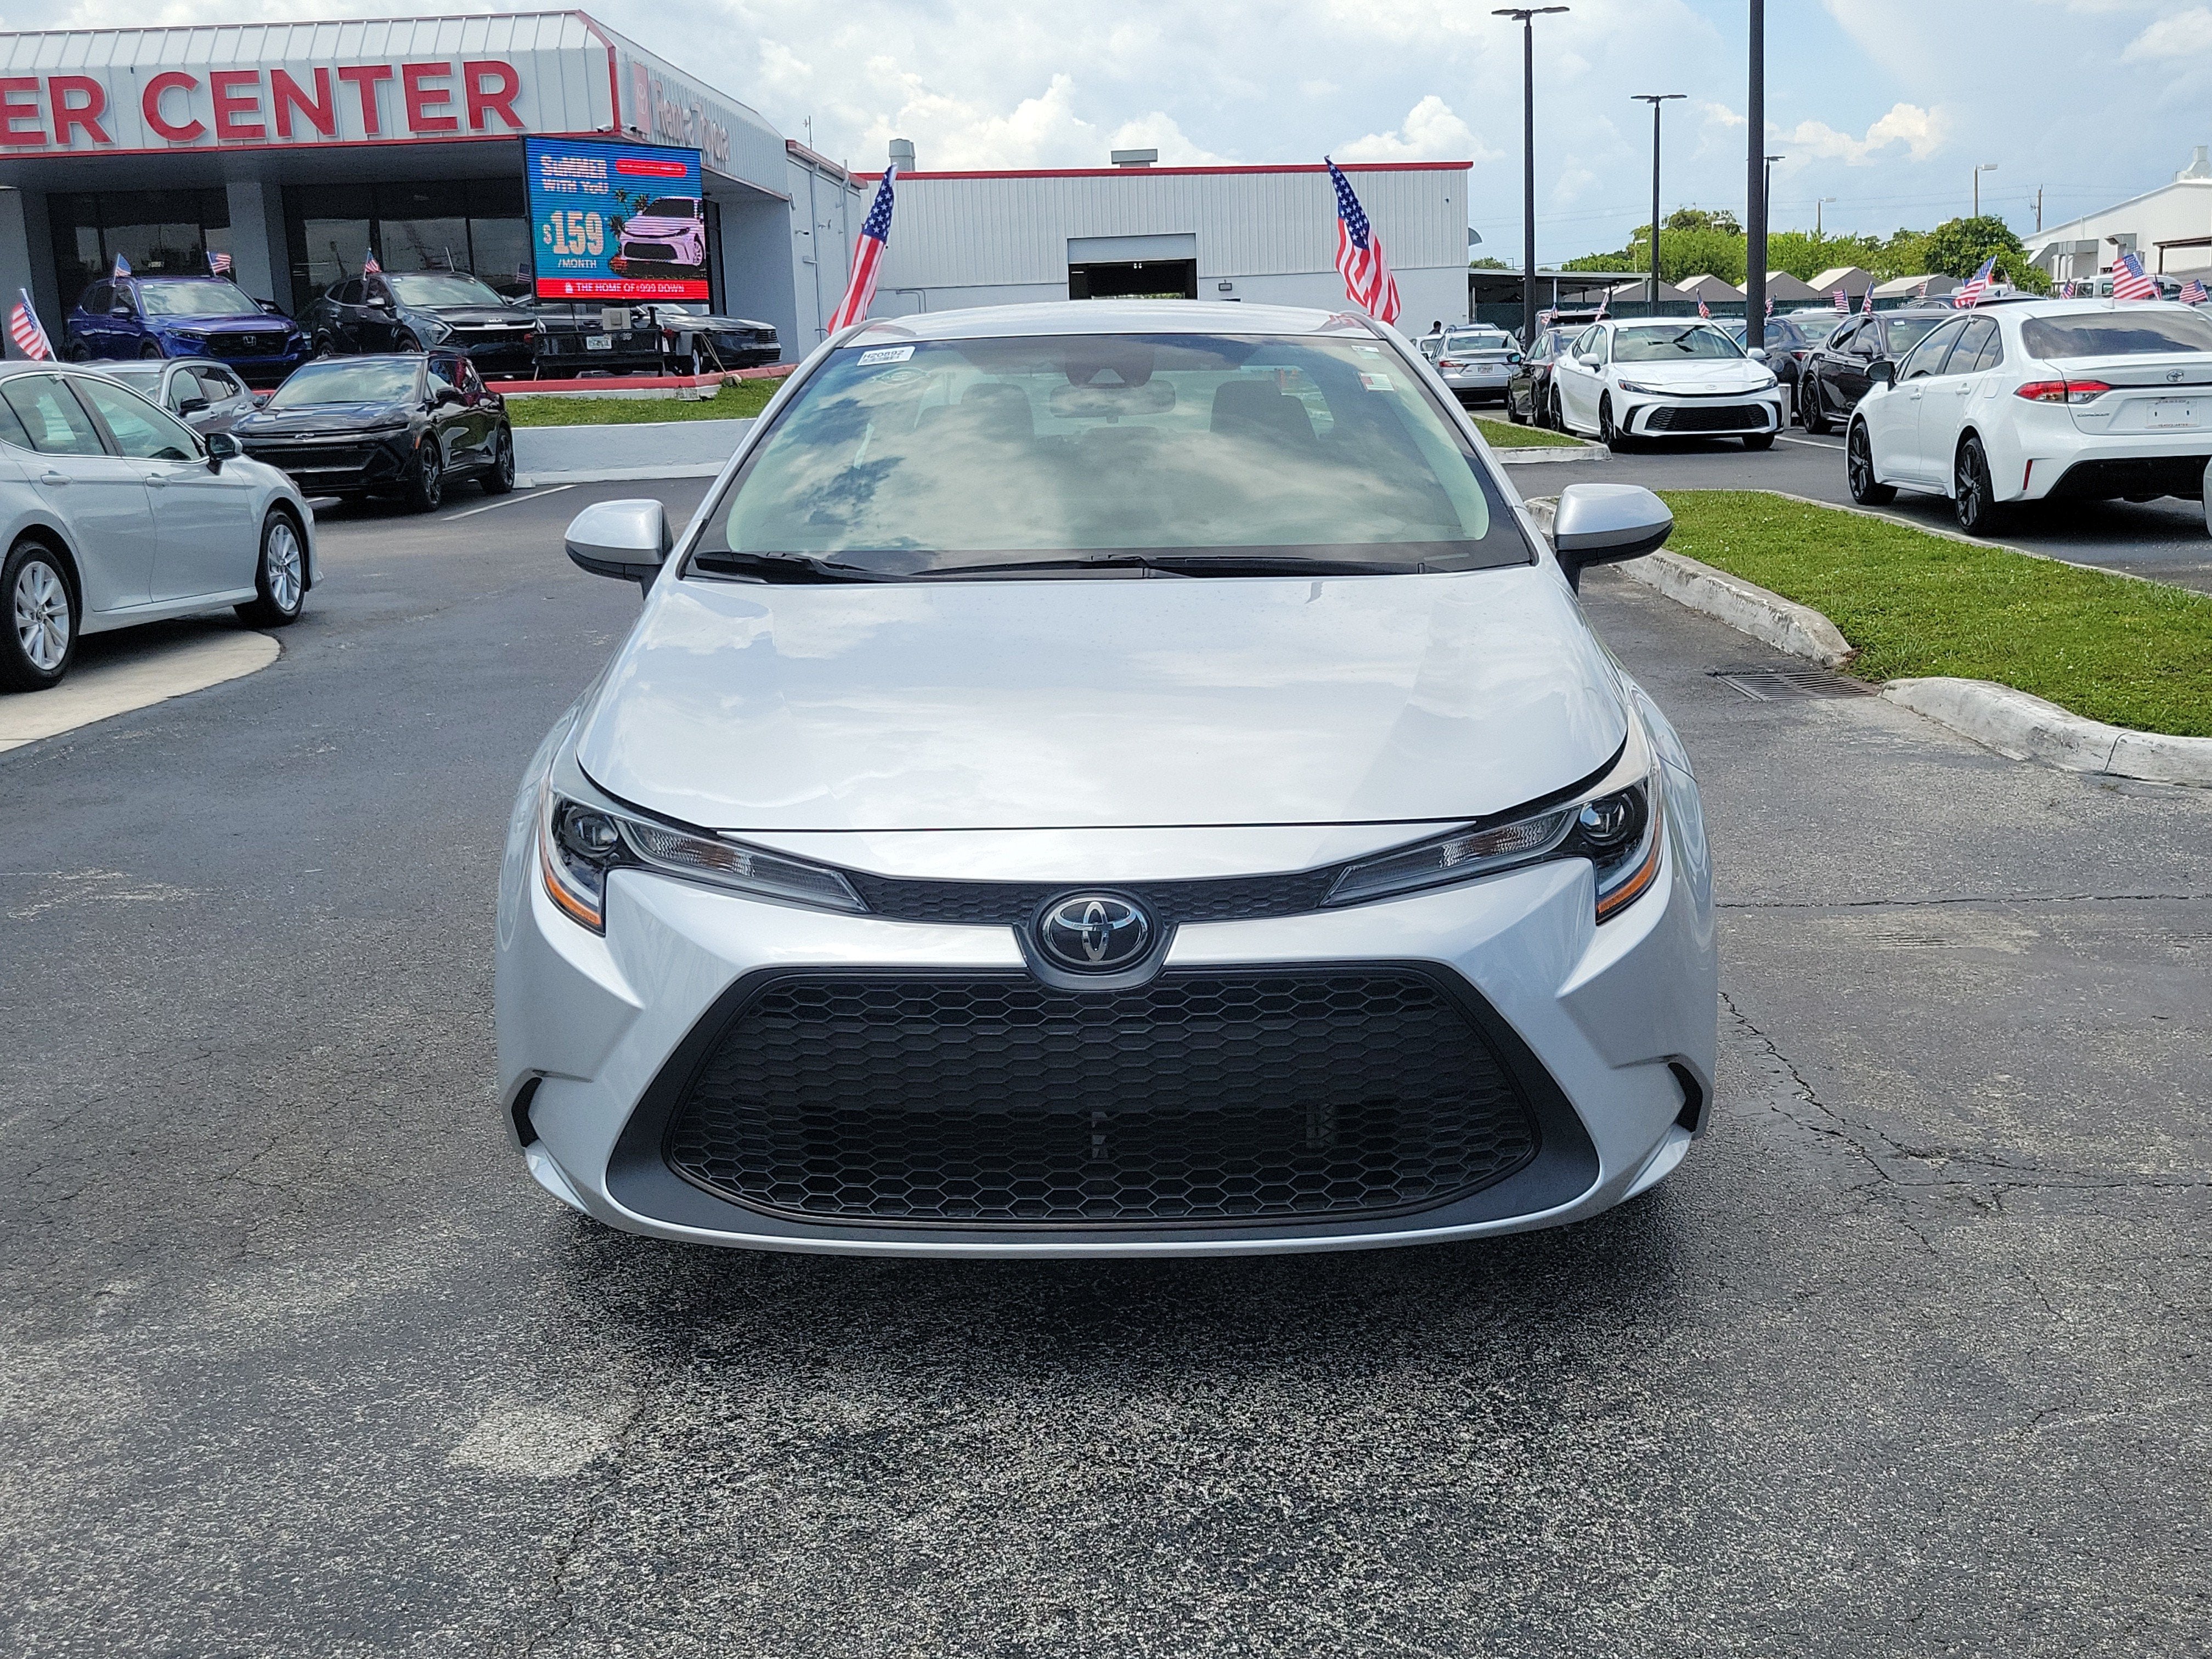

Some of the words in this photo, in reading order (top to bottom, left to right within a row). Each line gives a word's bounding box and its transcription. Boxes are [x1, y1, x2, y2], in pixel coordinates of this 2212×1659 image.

[0, 75, 113, 146] ER
[142, 60, 525, 142] CENTER
[543, 211, 604, 256] $159
[558, 258, 597, 268] /MONTH
[576, 282, 593, 291] THE
[595, 283, 621, 292] HOME
[623, 283, 635, 292] OF
[658, 284, 685, 292] DOWN
